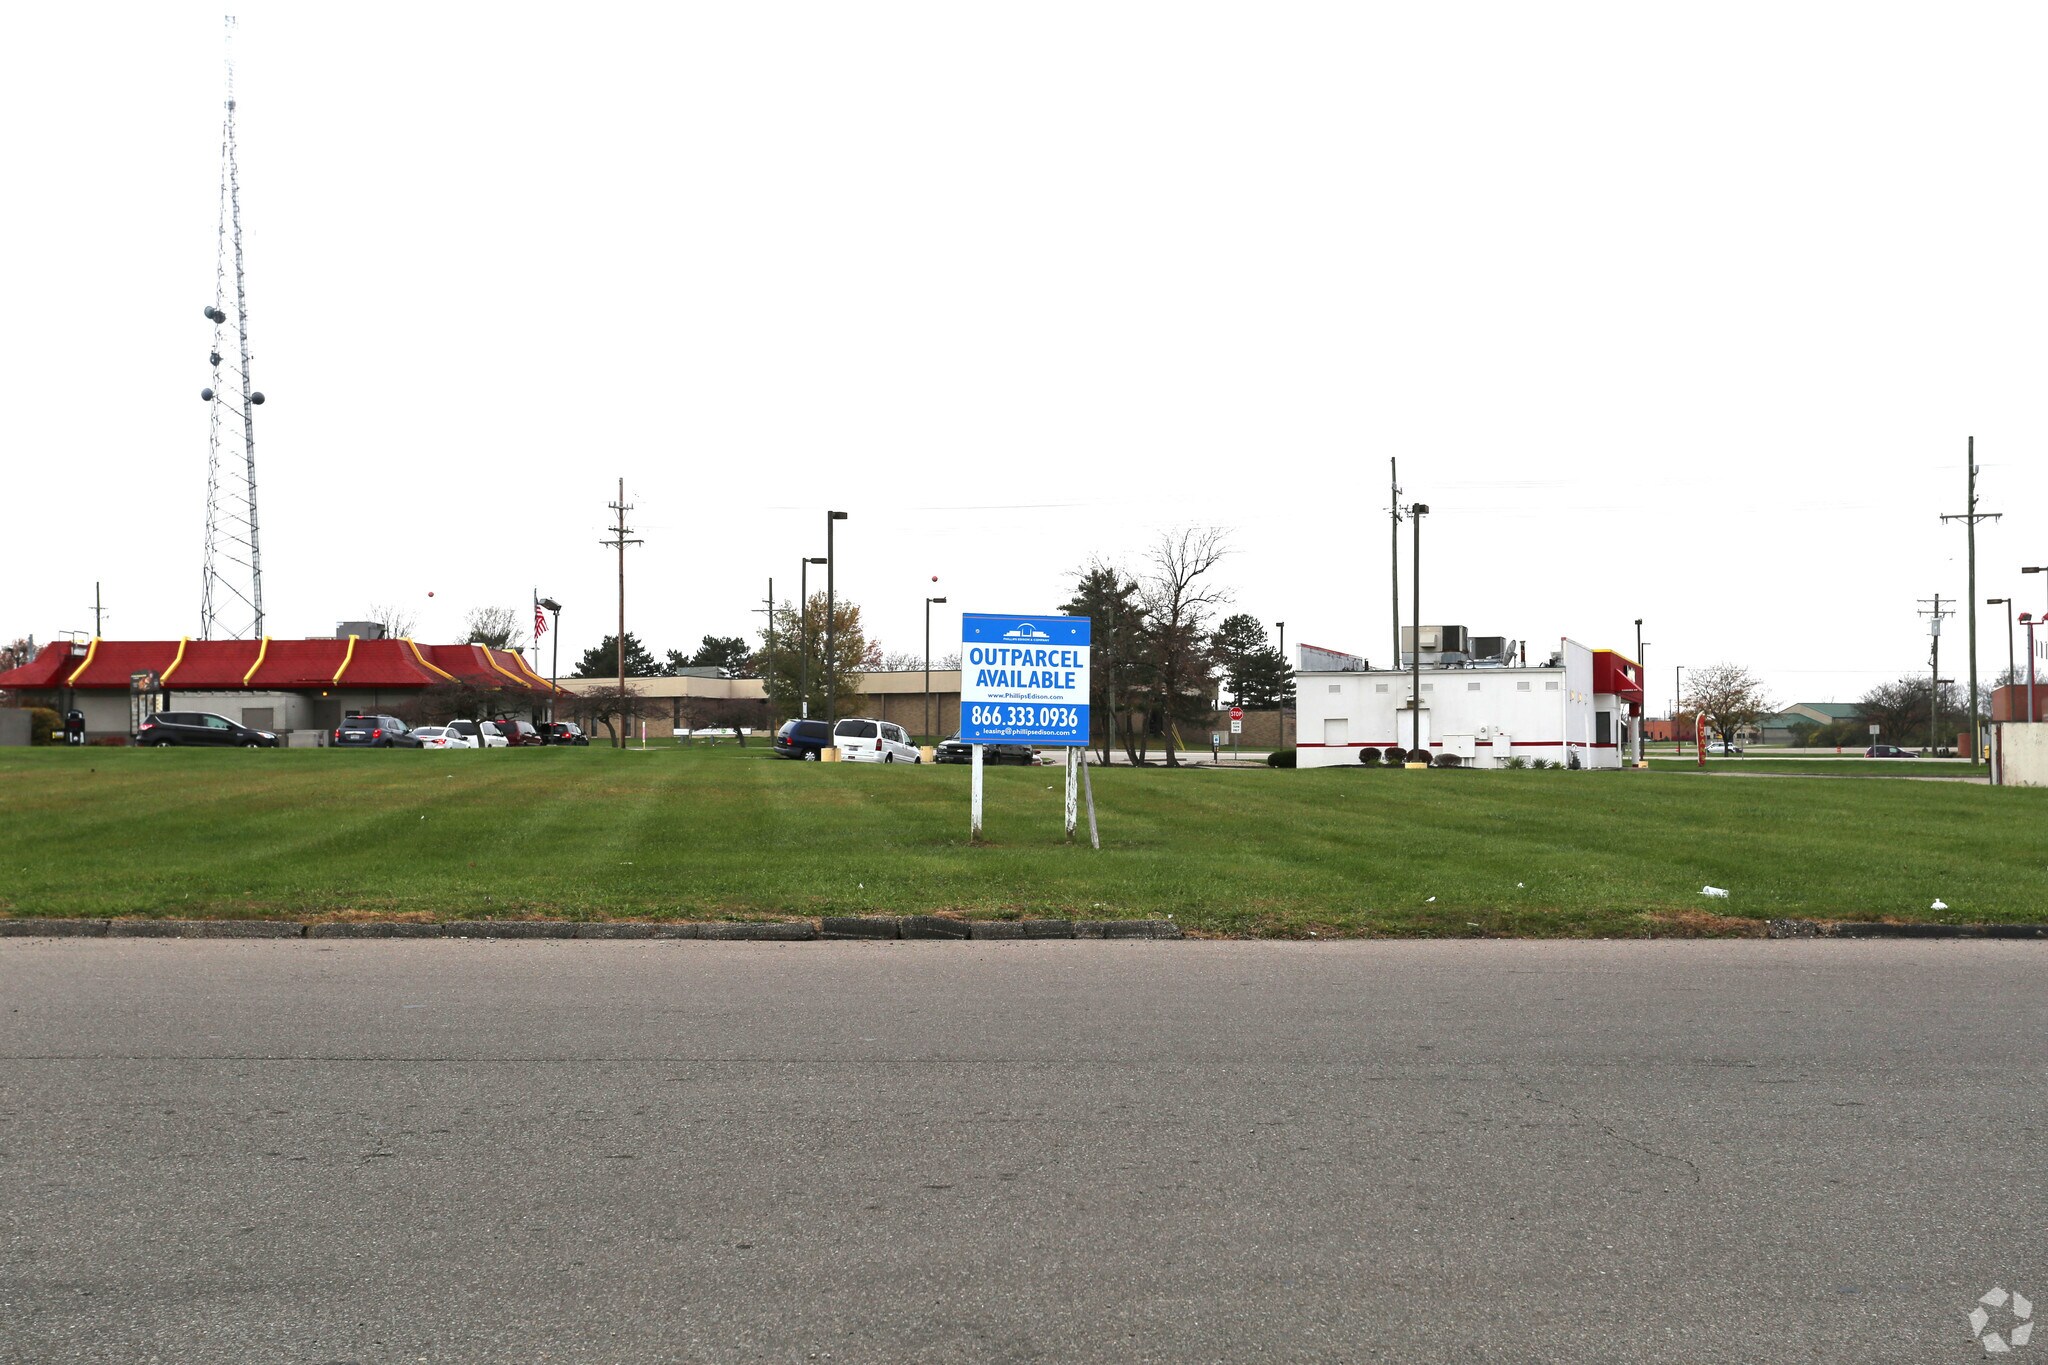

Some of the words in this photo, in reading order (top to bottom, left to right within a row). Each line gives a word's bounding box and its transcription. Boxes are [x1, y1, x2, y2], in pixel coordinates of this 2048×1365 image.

[970, 648, 1084, 668] OUTPARCEL
[976, 669, 1076, 689] AVAILABLE
[972, 706, 1078, 728] 866.333.0936
[983, 727, 1070, 736] leasing@phillipsedison.com
